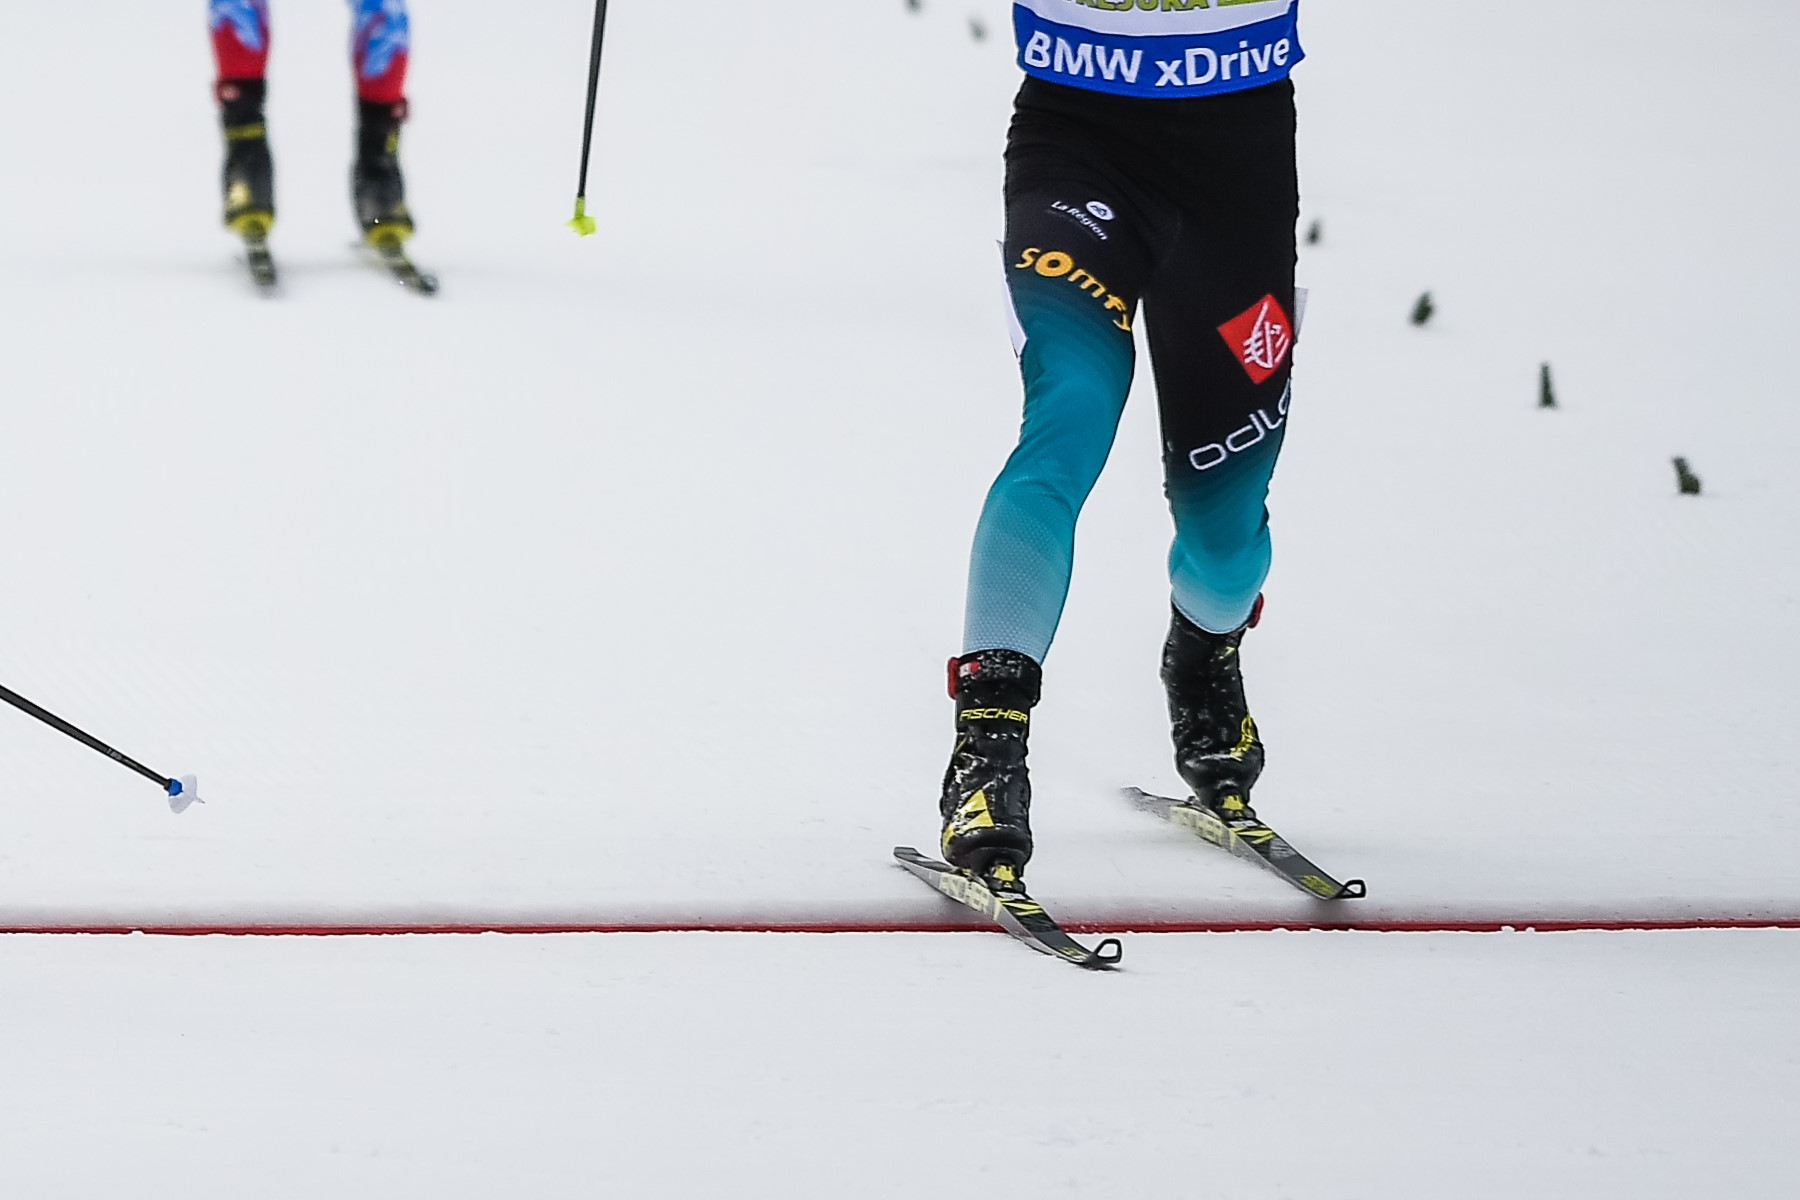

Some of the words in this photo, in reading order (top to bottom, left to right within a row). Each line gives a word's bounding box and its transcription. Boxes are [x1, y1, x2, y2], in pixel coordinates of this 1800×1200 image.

[1024, 30, 1143, 84] BMW
[1154, 36, 1290, 88] xDrive
[959, 707, 1029, 724] FISCHER
